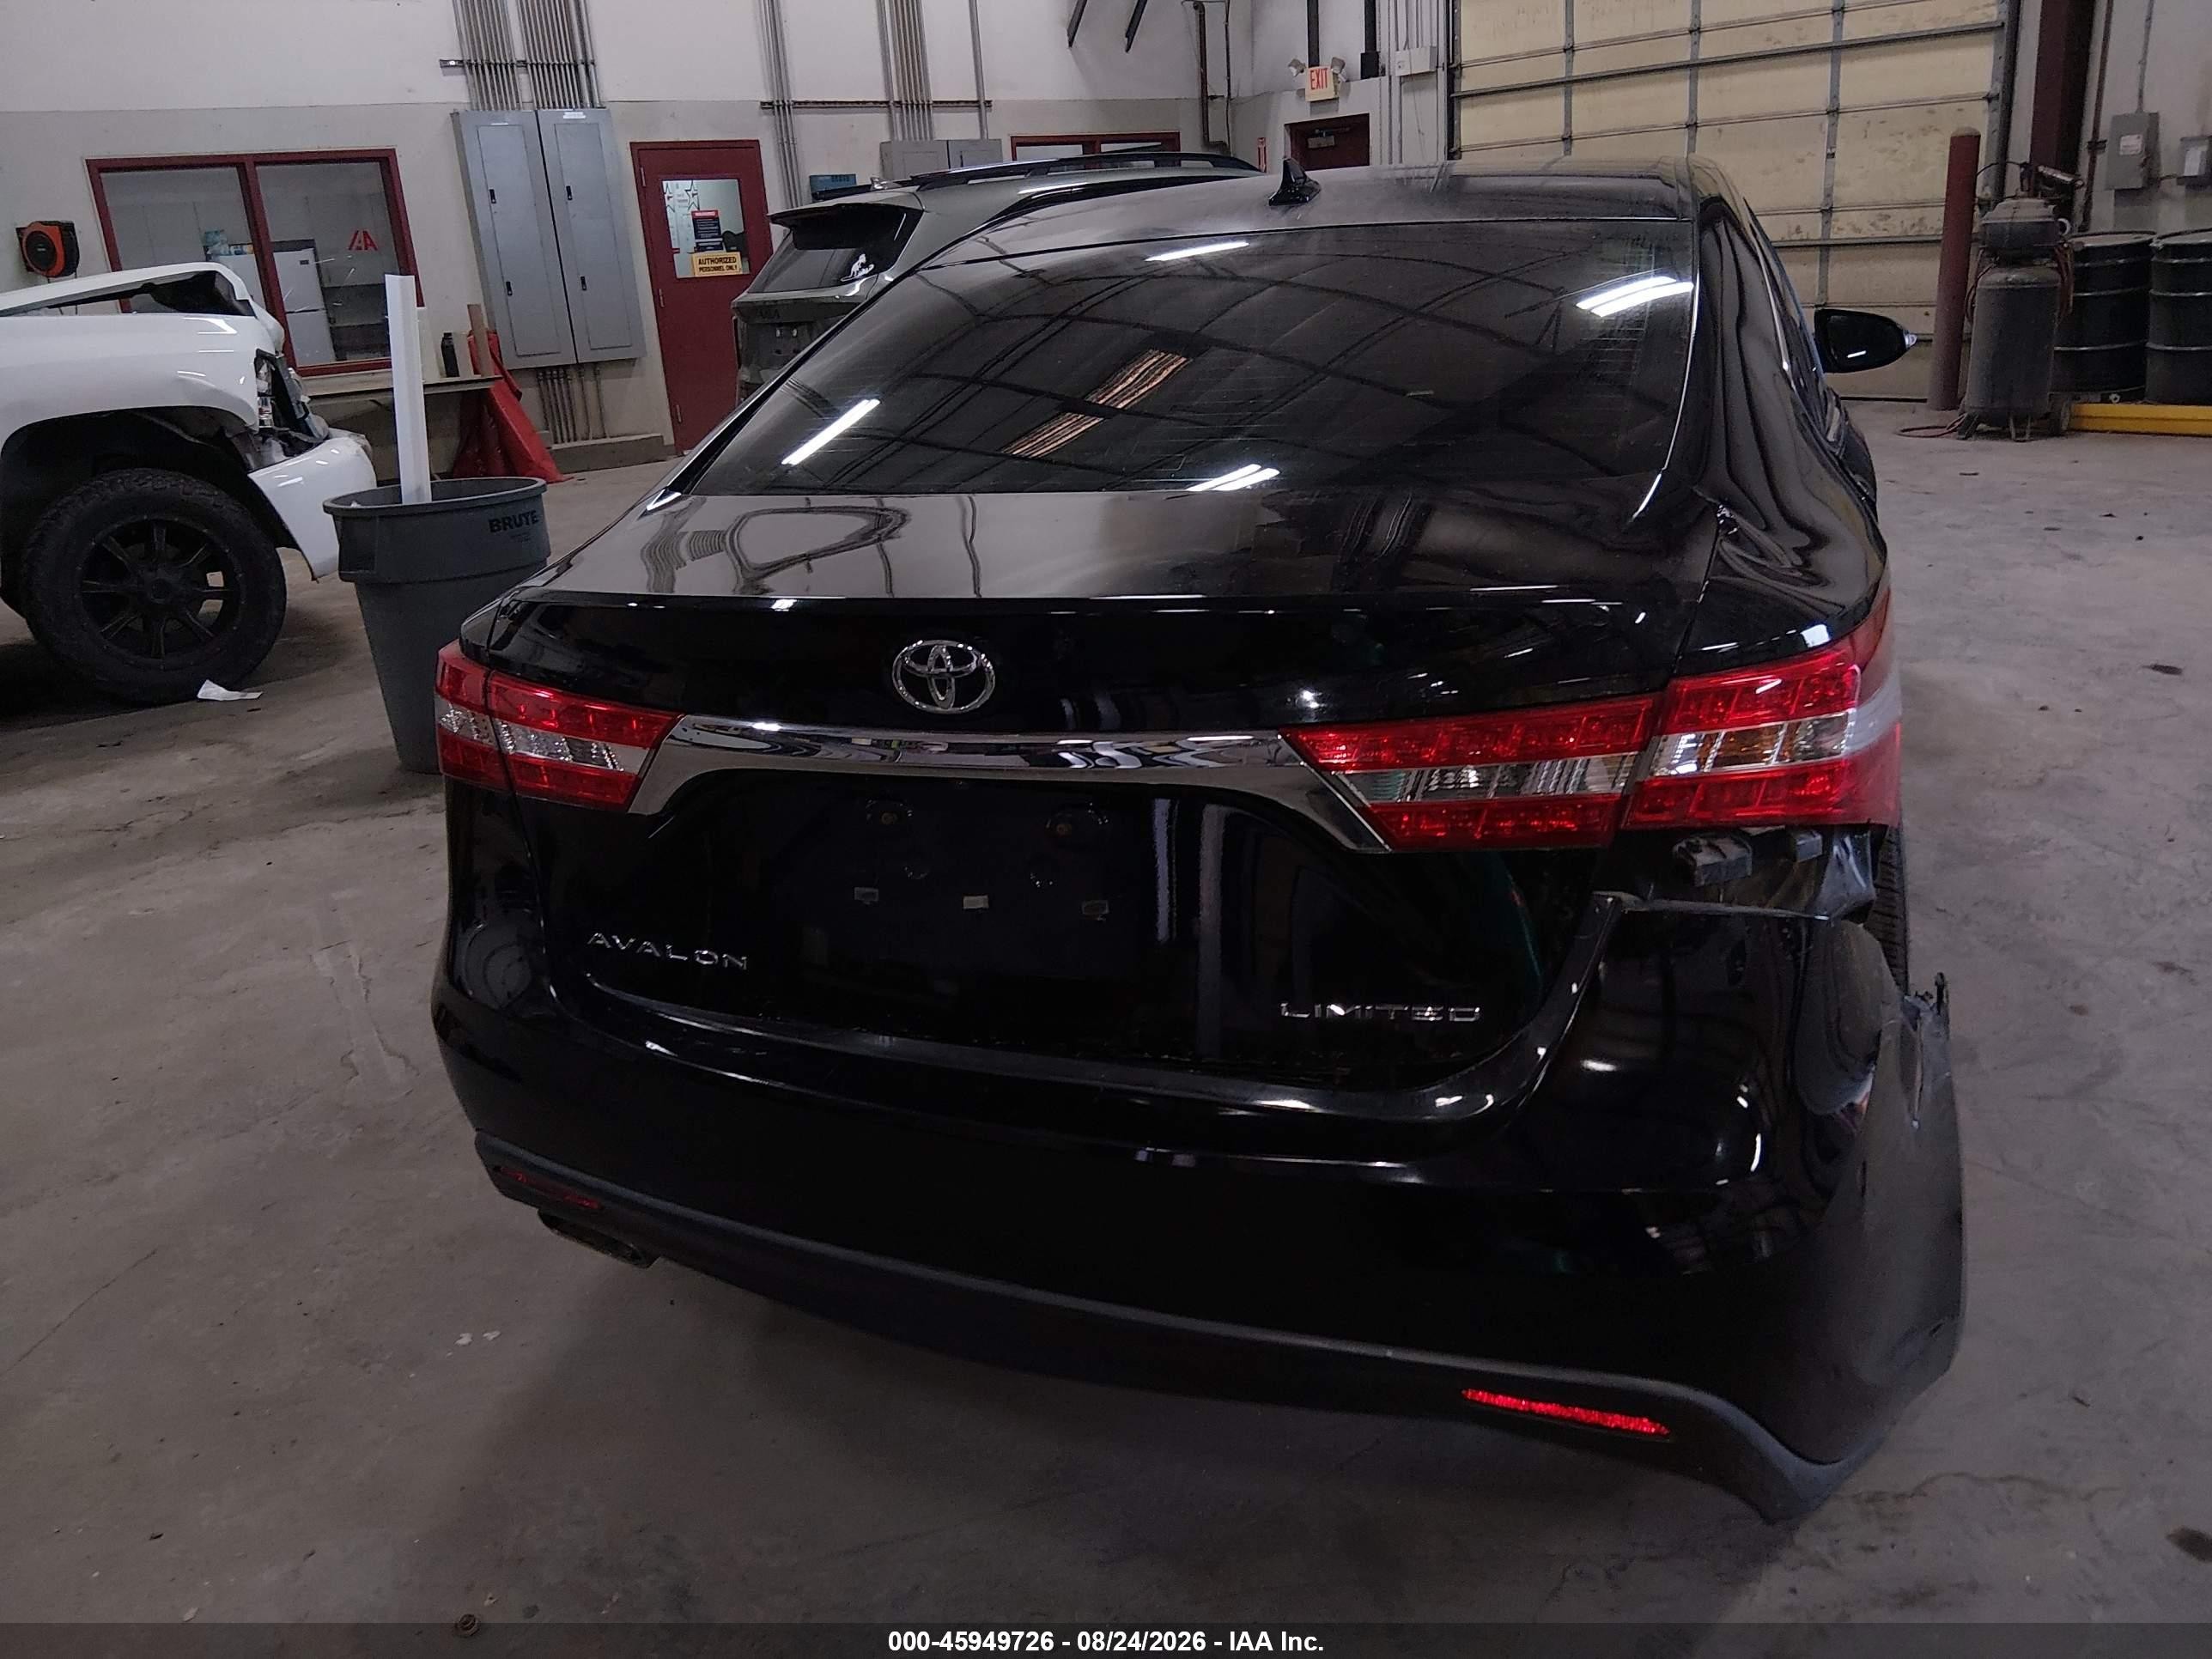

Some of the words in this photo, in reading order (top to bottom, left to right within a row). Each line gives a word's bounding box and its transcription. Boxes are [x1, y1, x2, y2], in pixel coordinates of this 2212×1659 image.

[1310, 68, 1328, 90] EXIT
[698, 256, 737, 265] AUTHORIZED
[488, 509, 539, 533] BRUTE
[587, 932, 747, 970] AVALON
[1279, 1002, 1480, 1023] LIMITED
